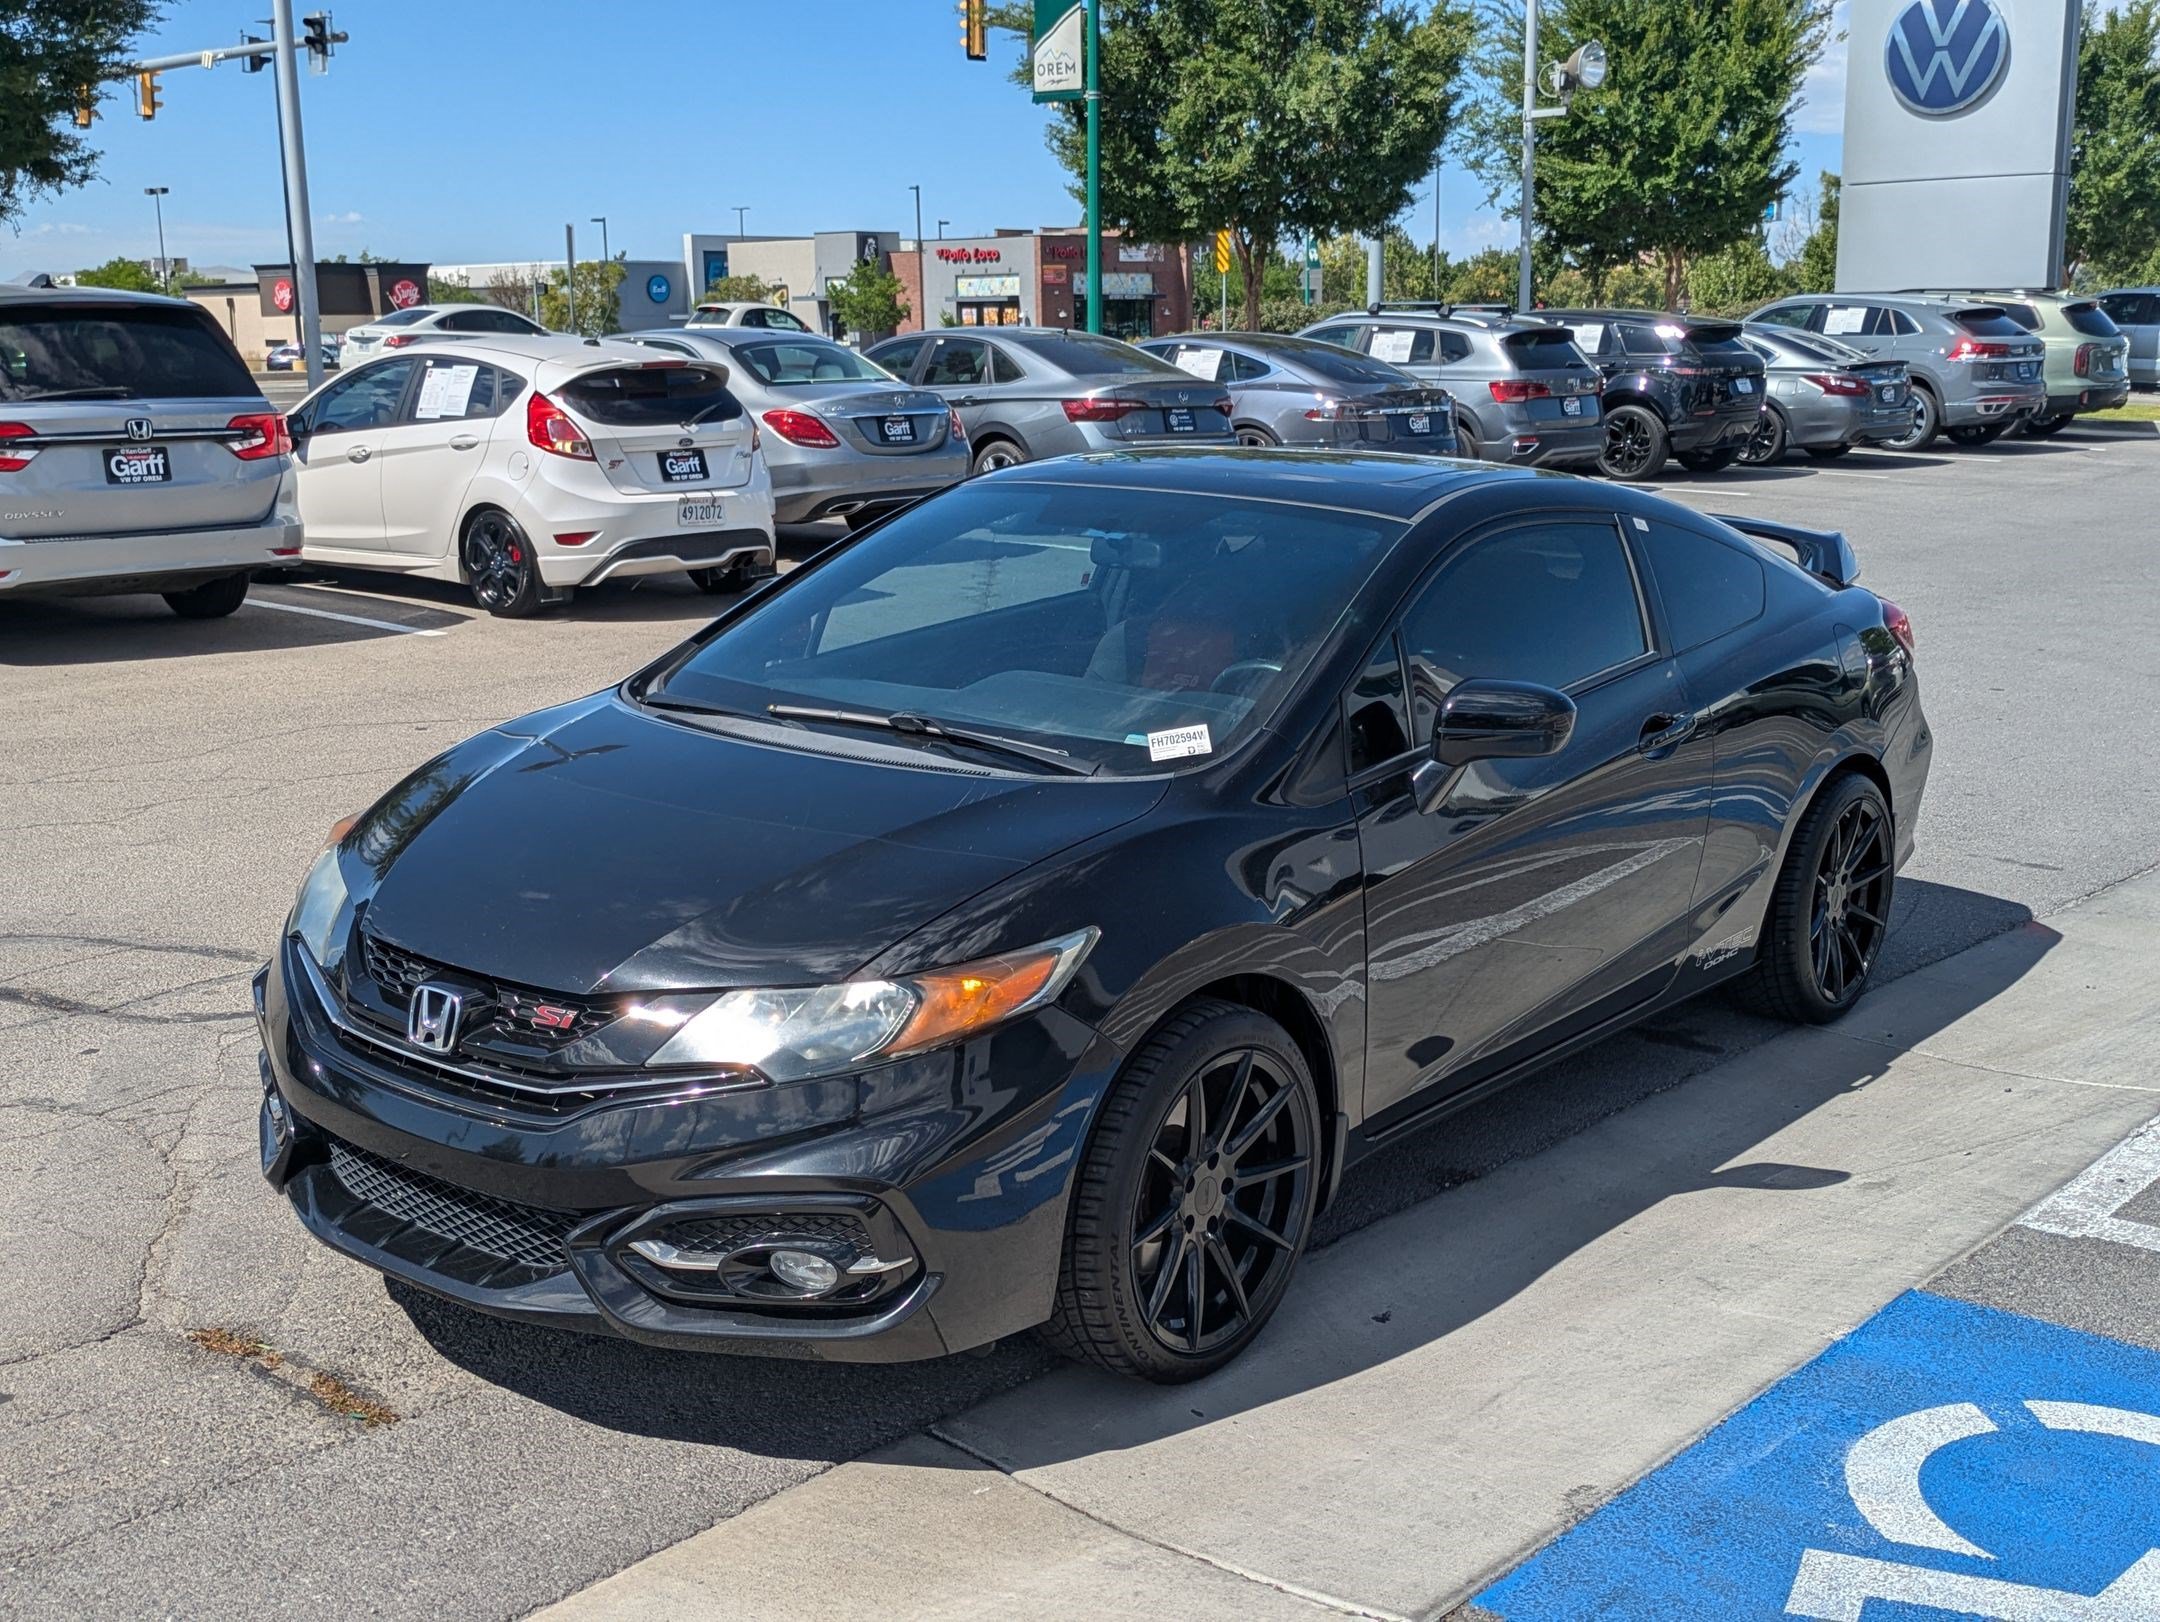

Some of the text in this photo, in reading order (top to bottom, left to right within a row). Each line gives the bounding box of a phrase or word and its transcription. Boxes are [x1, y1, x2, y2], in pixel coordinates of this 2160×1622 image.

[1037, 62, 1076, 77] OREM
[943, 247, 969, 261] Pollo
[973, 247, 999, 260] Loco
[393, 282, 420, 305] Swig
[884, 421, 910, 435] Garff
[110, 454, 165, 477] Garff
[665, 456, 701, 474] Garff
[4, 510, 65, 520] ODYSSEY
[682, 505, 722, 520] 4912072
[1703, 947, 1739, 971] DOHC
[531, 1004, 580, 1030] Si
